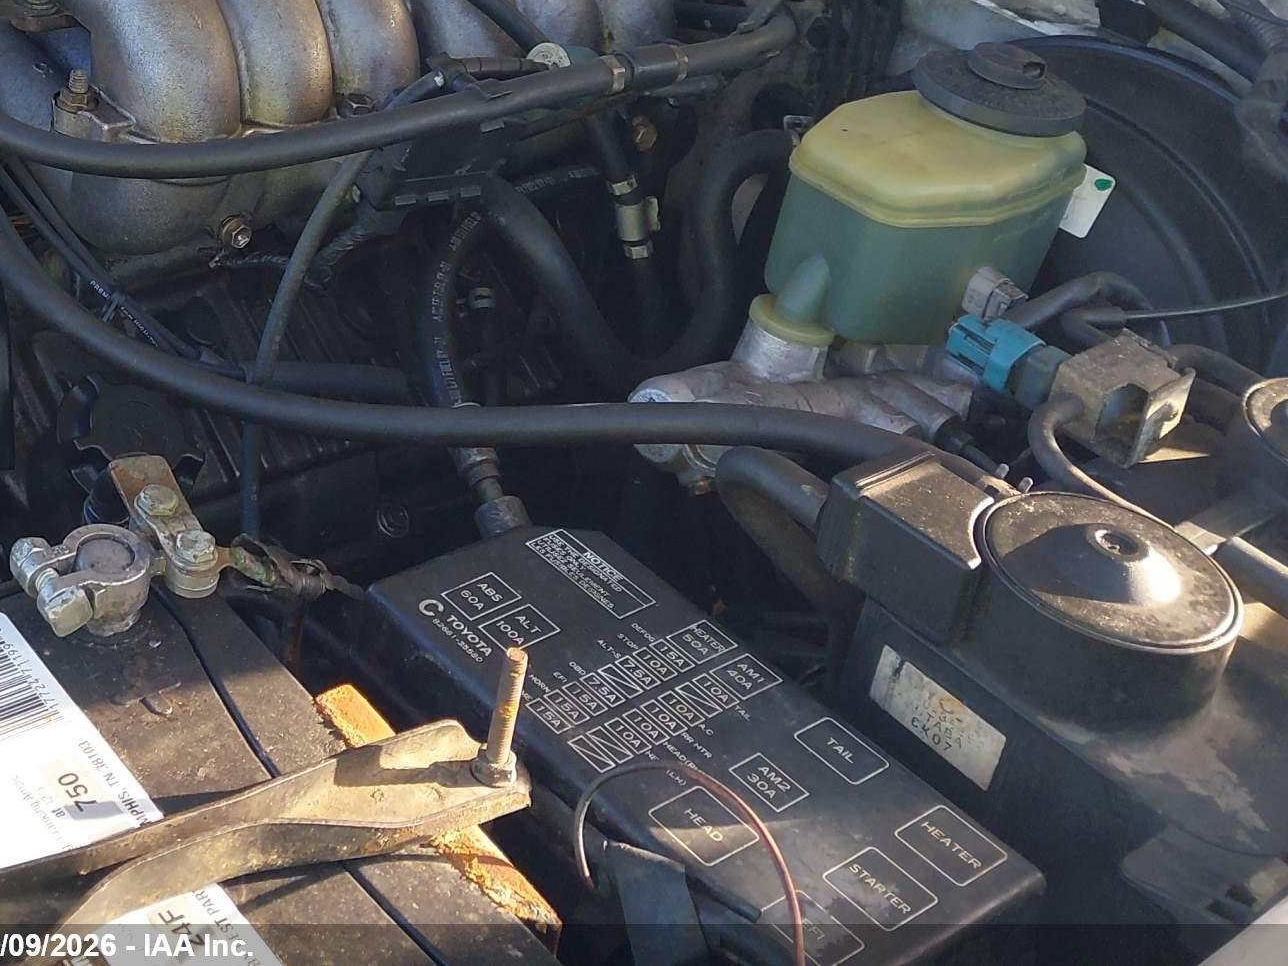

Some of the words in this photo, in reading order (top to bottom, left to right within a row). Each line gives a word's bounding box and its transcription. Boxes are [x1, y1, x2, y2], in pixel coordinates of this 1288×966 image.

[543, 537, 567, 556] FUSES
[549, 535, 565, 547] USE
[564, 546, 578, 558] THE
[578, 557, 623, 592] DESIGNATED
[582, 551, 624, 582] NOTICE
[461, 589, 485, 611] 60A
[477, 582, 503, 602] ABS
[446, 614, 493, 656] TOYOTA
[496, 620, 525, 645] 100A
[515, 614, 542, 634] ALT
[631, 622, 655, 642] DEFOG
[597, 638, 622, 660] ALT-S
[617, 633, 640, 650] STOP
[682, 634, 710, 657] 50A
[691, 625, 725, 653] HEATER
[3, 642, 33, 681] 71199
[641, 654, 668, 676] 10A
[660, 645, 686, 667] 15A
[529, 674, 551, 693] HORN
[623, 661, 652, 684] 7.5A
[727, 670, 753, 691] 40A
[737, 663, 765, 684] AM1
[572, 687, 598, 710] 15A
[588, 677, 616, 702] 7.5A
[703, 680, 730, 703] 10A
[536, 704, 562, 729] 15A
[554, 696, 580, 719] 15A
[651, 706, 678, 731] 10A
[667, 697, 695, 721] 10A
[734, 705, 751, 721] TAIL
[615, 724, 642, 748] 10A
[633, 715, 660, 740] 10A
[78, 738, 109, 773] 38103
[825, 736, 855, 764] TAIL
[103, 771, 120, 789] TN
[746, 773, 777, 799] 30A
[758, 765, 792, 793] AM2
[58, 771, 98, 814] 750
[682, 807, 724, 842] HEAD
[920, 820, 983, 870] HEATER
[848, 862, 912, 915] STARTER
